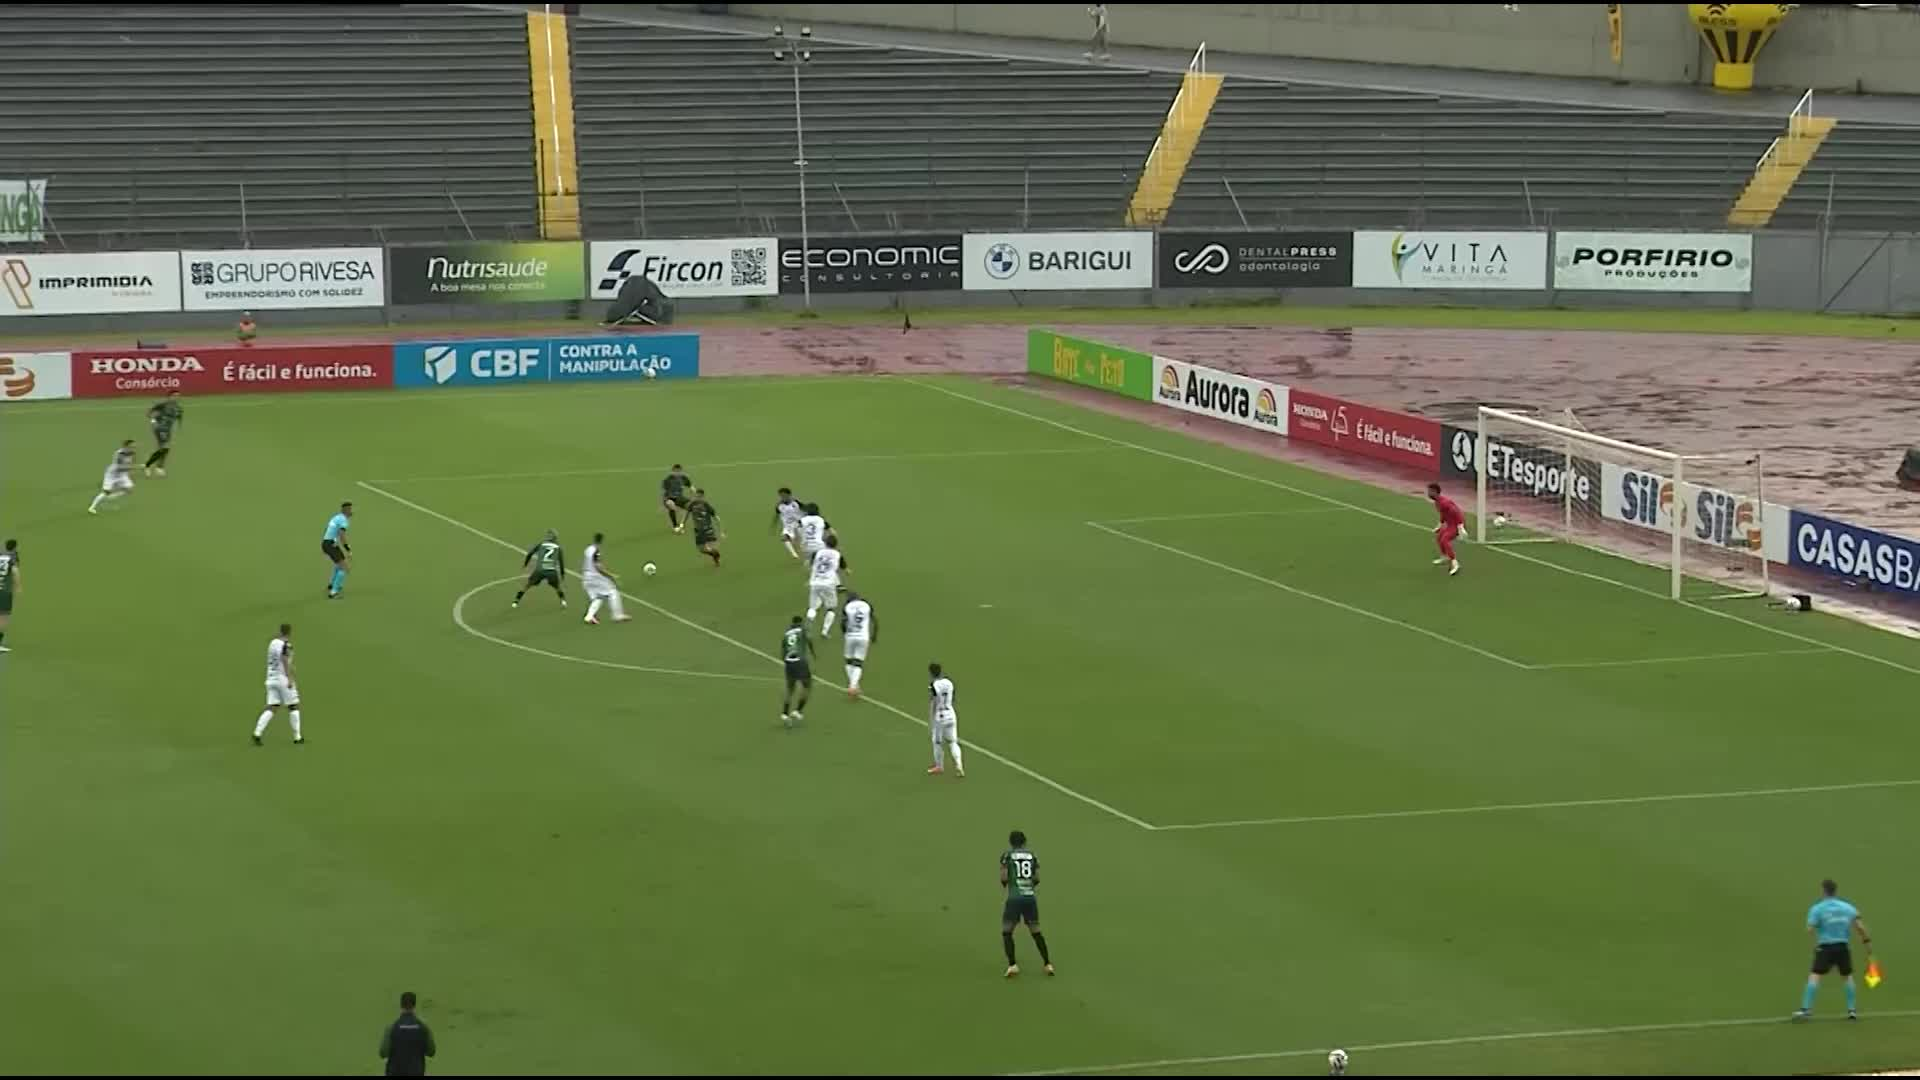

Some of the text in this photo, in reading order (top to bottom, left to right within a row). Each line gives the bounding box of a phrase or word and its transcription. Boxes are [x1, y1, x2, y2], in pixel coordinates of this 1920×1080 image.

[1028, 250, 1132, 271] BARIGUI
[1423, 243, 1508, 261] VITA
[1572, 248, 1734, 267] PORFIRIO
[216, 262, 297, 283] GRUPO
[300, 260, 375, 282] RIVESA
[643, 255, 723, 282] Fircon
[1604, 268, 1699, 279] PRODUÇÕES
[430, 283, 439, 292] A
[559, 343, 638, 358] CONTRA A
[89, 356, 205, 373] HONDA
[223, 360, 377, 381] É fácil e funciona.
[470, 348, 540, 378] CBF
[559, 355, 672, 373] MANIPULAÇÃO
[115, 376, 180, 389] Consórcio
[1185, 370, 1249, 419] Aurora
[1014, 859, 1032, 878] 18
